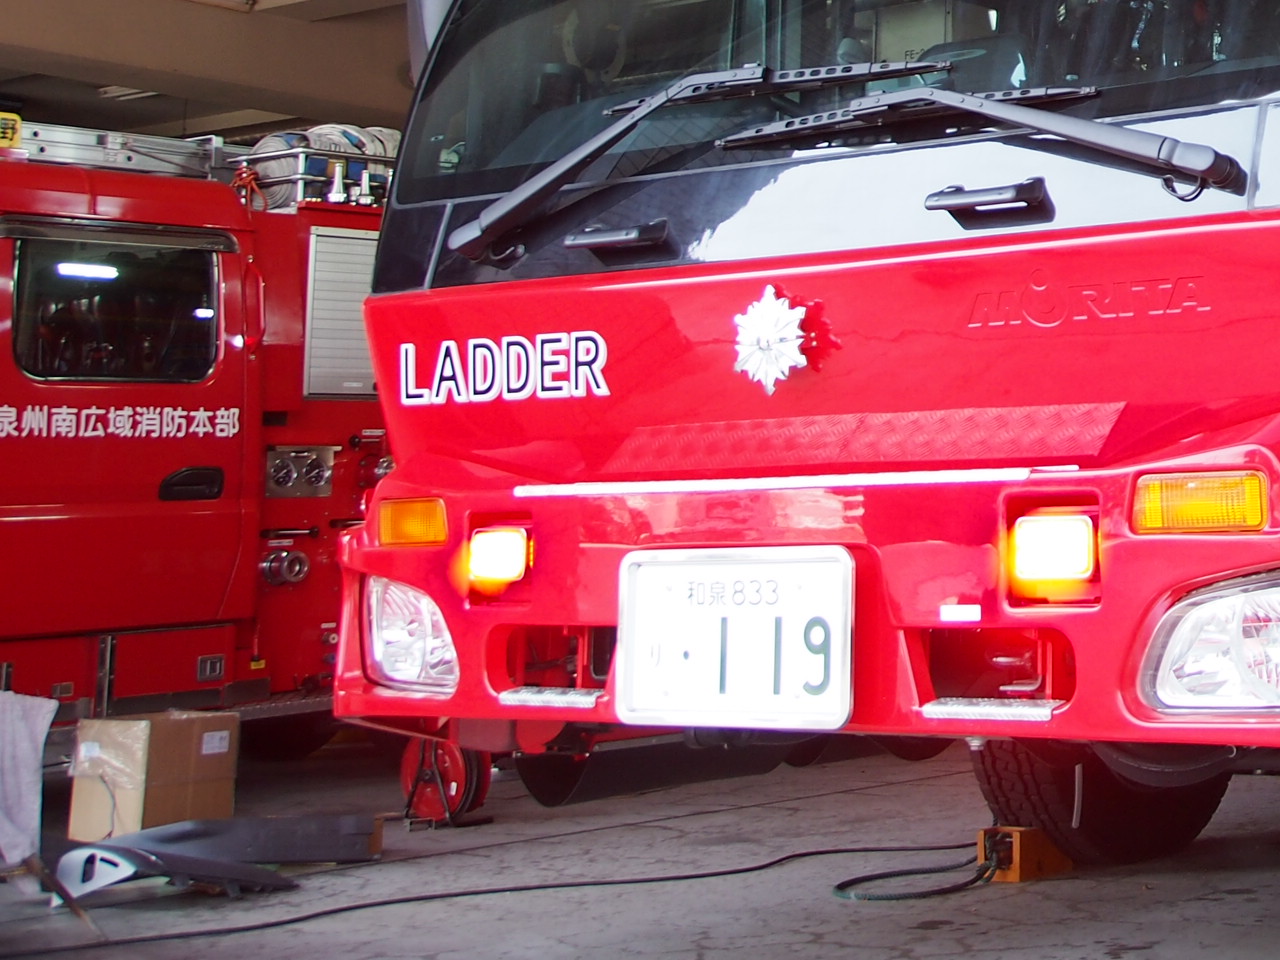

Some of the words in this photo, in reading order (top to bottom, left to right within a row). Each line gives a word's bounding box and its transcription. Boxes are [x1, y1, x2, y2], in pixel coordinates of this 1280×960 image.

[967, 269, 1211, 328] MORITA
[400, 331, 611, 406] LADDER
[0, 405, 240, 438] 泉州南広域消防本部
